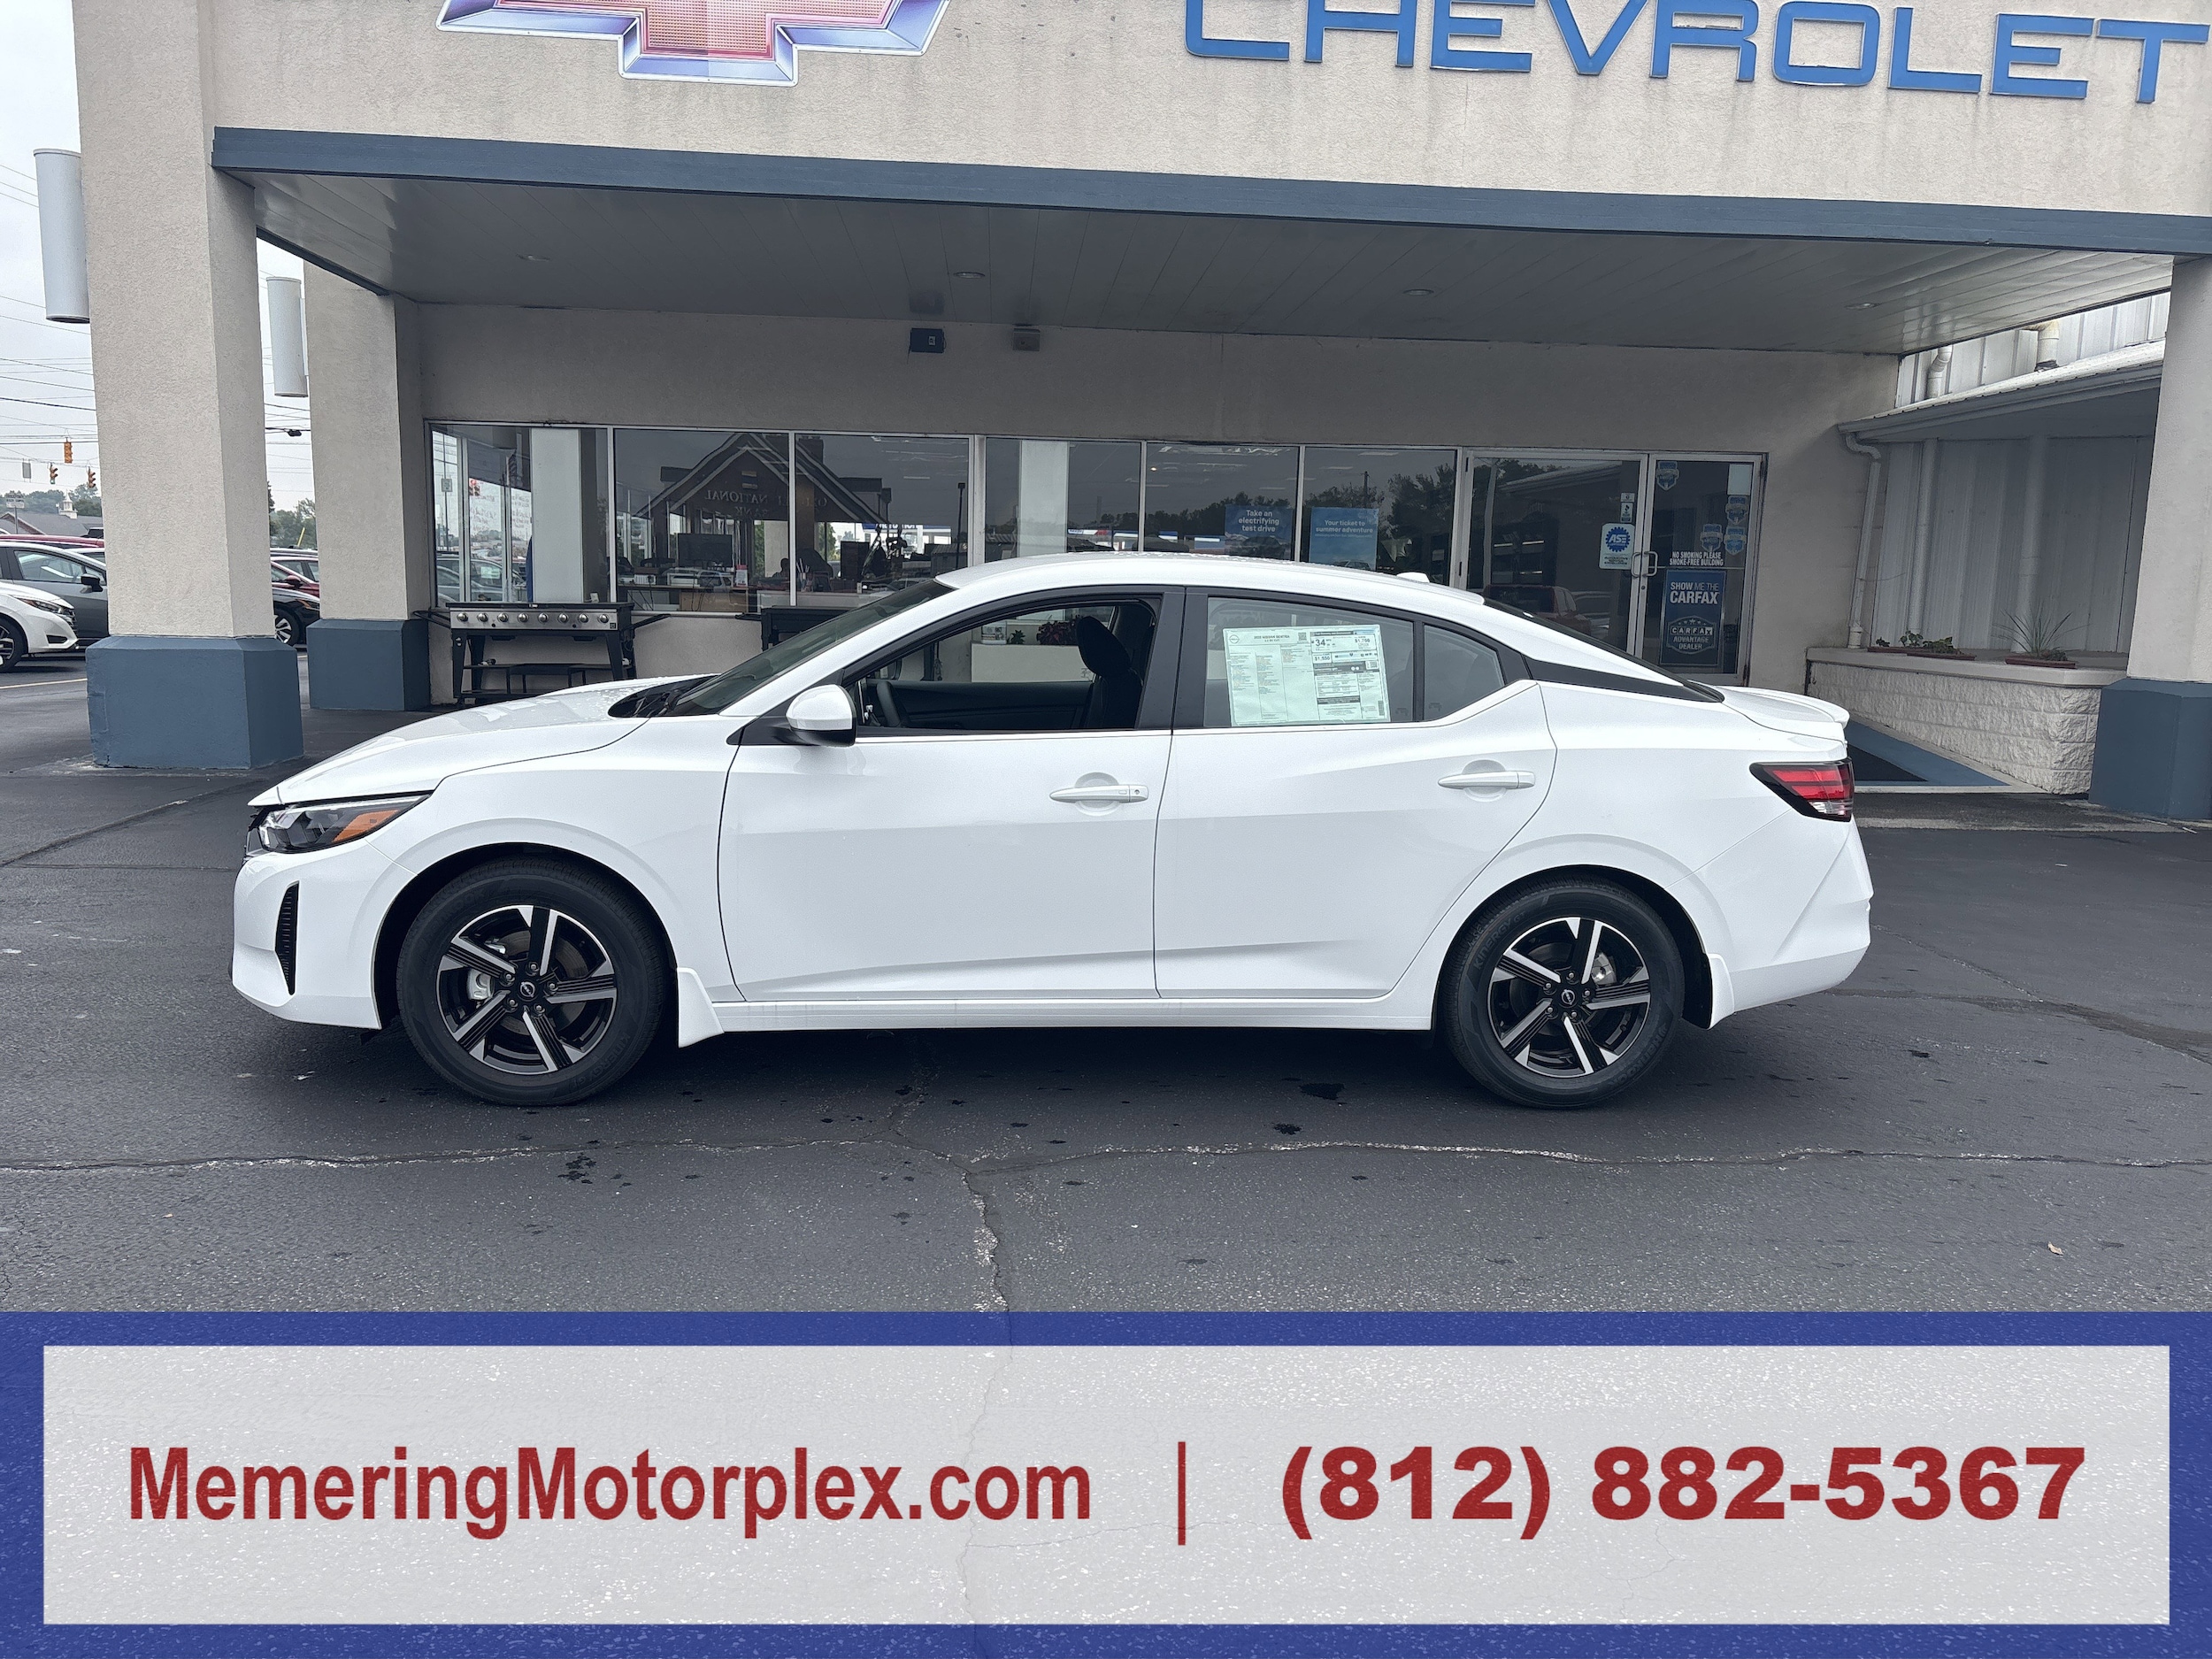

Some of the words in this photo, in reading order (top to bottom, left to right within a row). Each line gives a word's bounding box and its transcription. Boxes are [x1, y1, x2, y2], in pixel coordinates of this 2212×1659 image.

[1185, 0, 2208, 104] CHEVROLET
[1239, 517, 1279, 526] electrifying
[1609, 534, 1627, 543] ASE
[1694, 582, 1704, 591] ME
[1670, 591, 1719, 604] CARFAX
[1671, 626, 1712, 635] CARFAX
